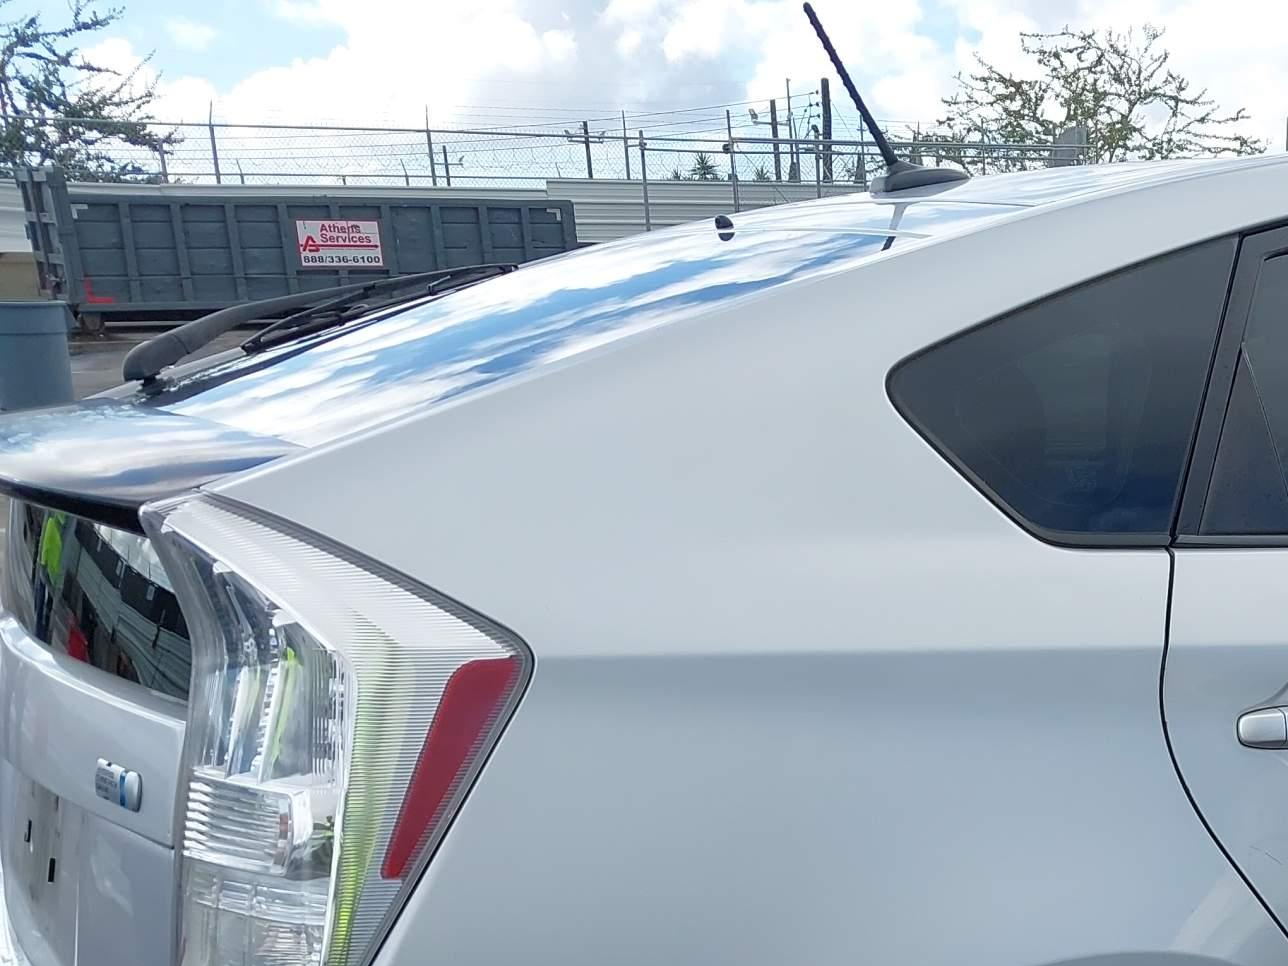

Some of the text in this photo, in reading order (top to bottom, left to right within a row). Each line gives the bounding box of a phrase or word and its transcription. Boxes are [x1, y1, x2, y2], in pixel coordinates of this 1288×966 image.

[320, 223, 361, 234] Athens
[320, 233, 372, 244] Services
[303, 255, 380, 264] 888/336-6100
